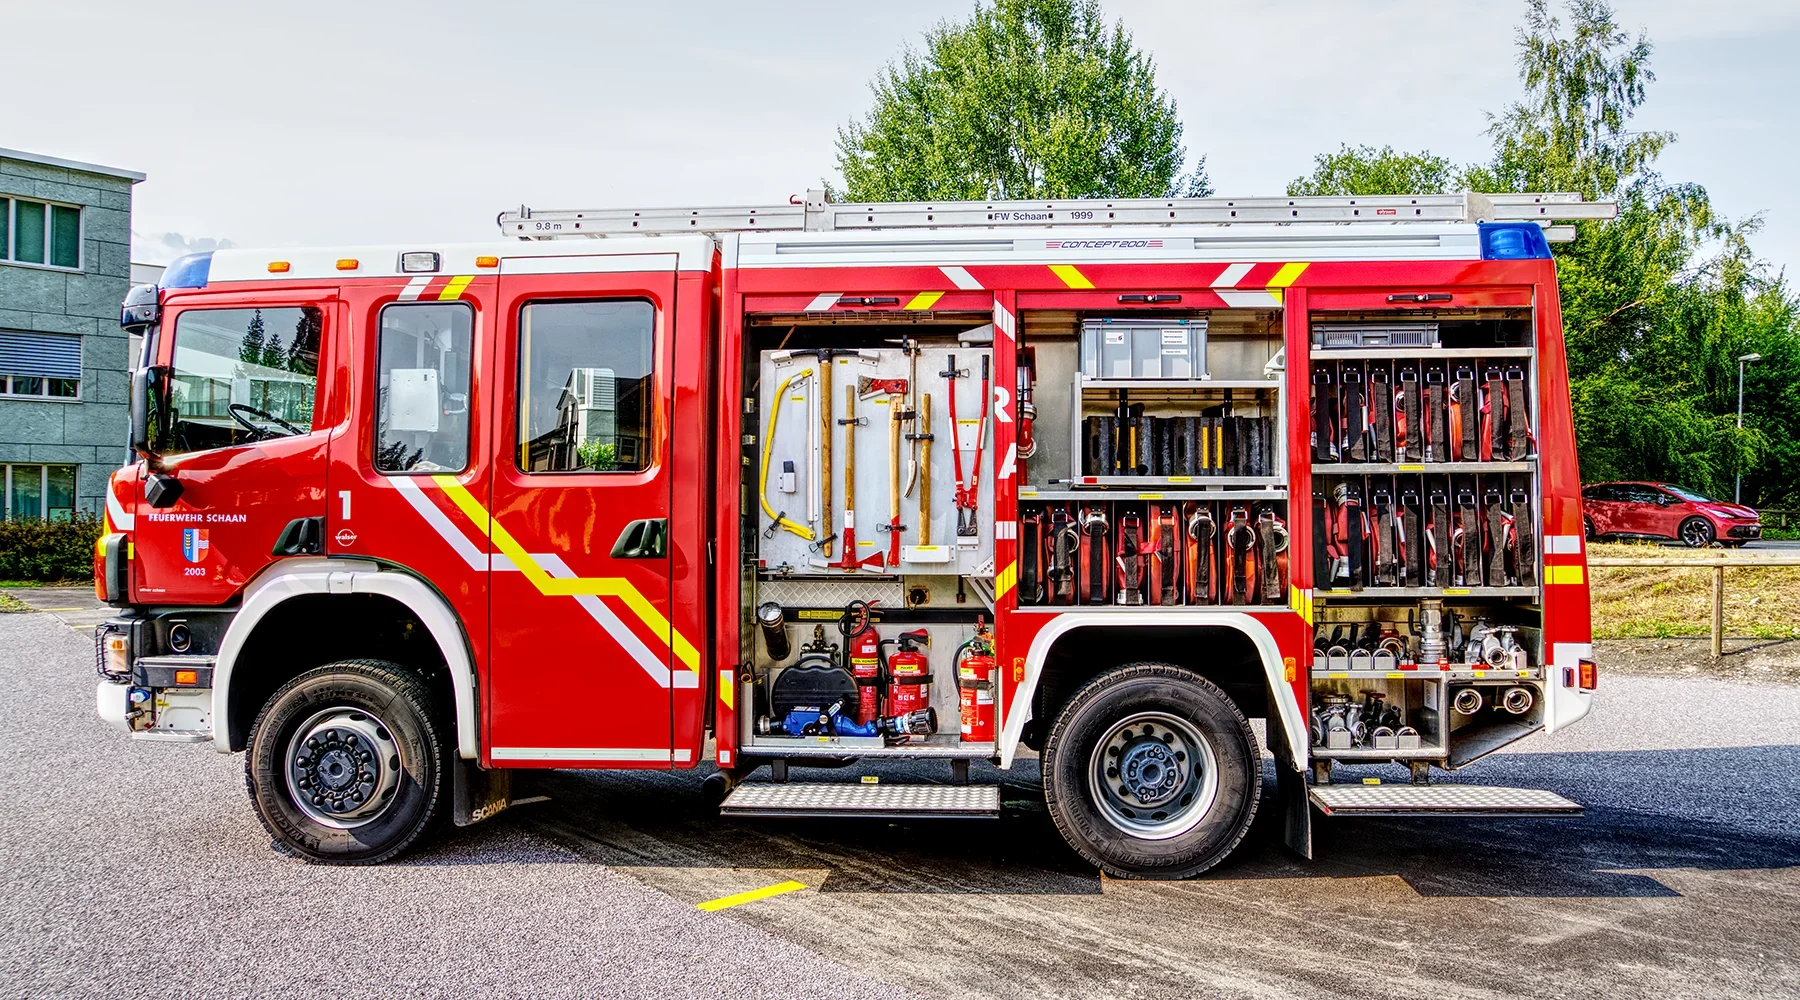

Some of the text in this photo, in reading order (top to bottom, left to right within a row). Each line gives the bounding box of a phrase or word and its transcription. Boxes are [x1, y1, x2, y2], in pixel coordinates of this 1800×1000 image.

[994, 212, 1048, 221] FW Schaan
[1070, 211, 1093, 220] 1999
[338, 490, 352, 520] 1
[148, 513, 247, 523] FEUERWEHR SCHAAN
[335, 533, 357, 541] walser
[184, 567, 206, 576] 2003
[472, 798, 507, 822] SCANIA
